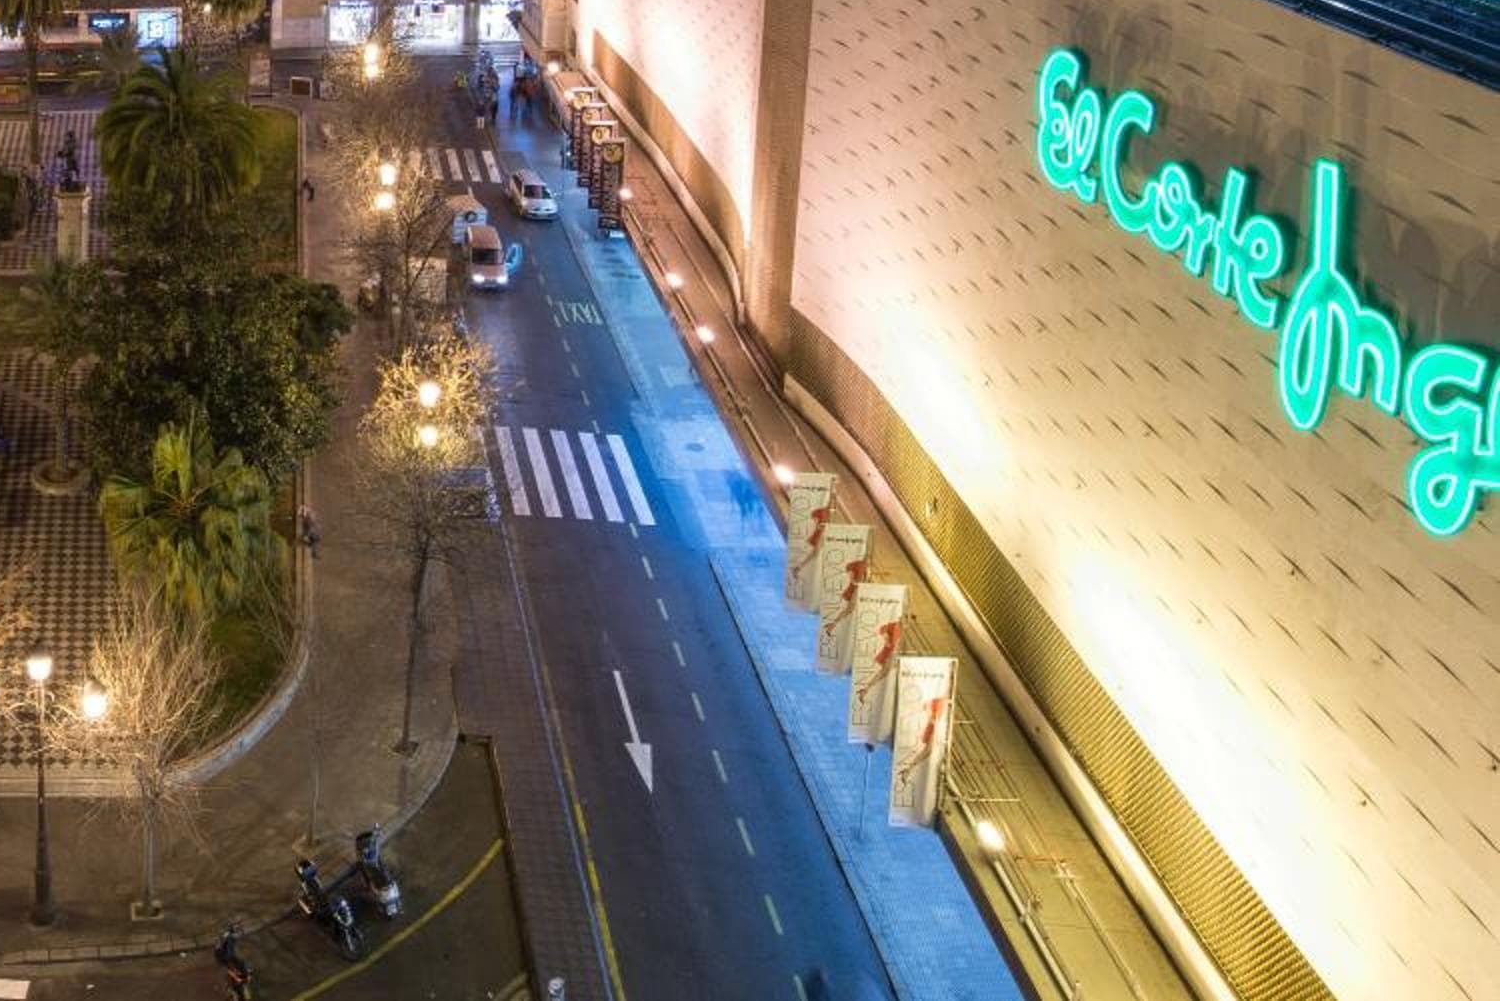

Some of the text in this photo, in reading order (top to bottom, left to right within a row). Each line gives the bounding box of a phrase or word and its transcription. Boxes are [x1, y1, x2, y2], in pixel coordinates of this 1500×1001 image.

[1036, 48, 1500, 536] El Corte Ing
